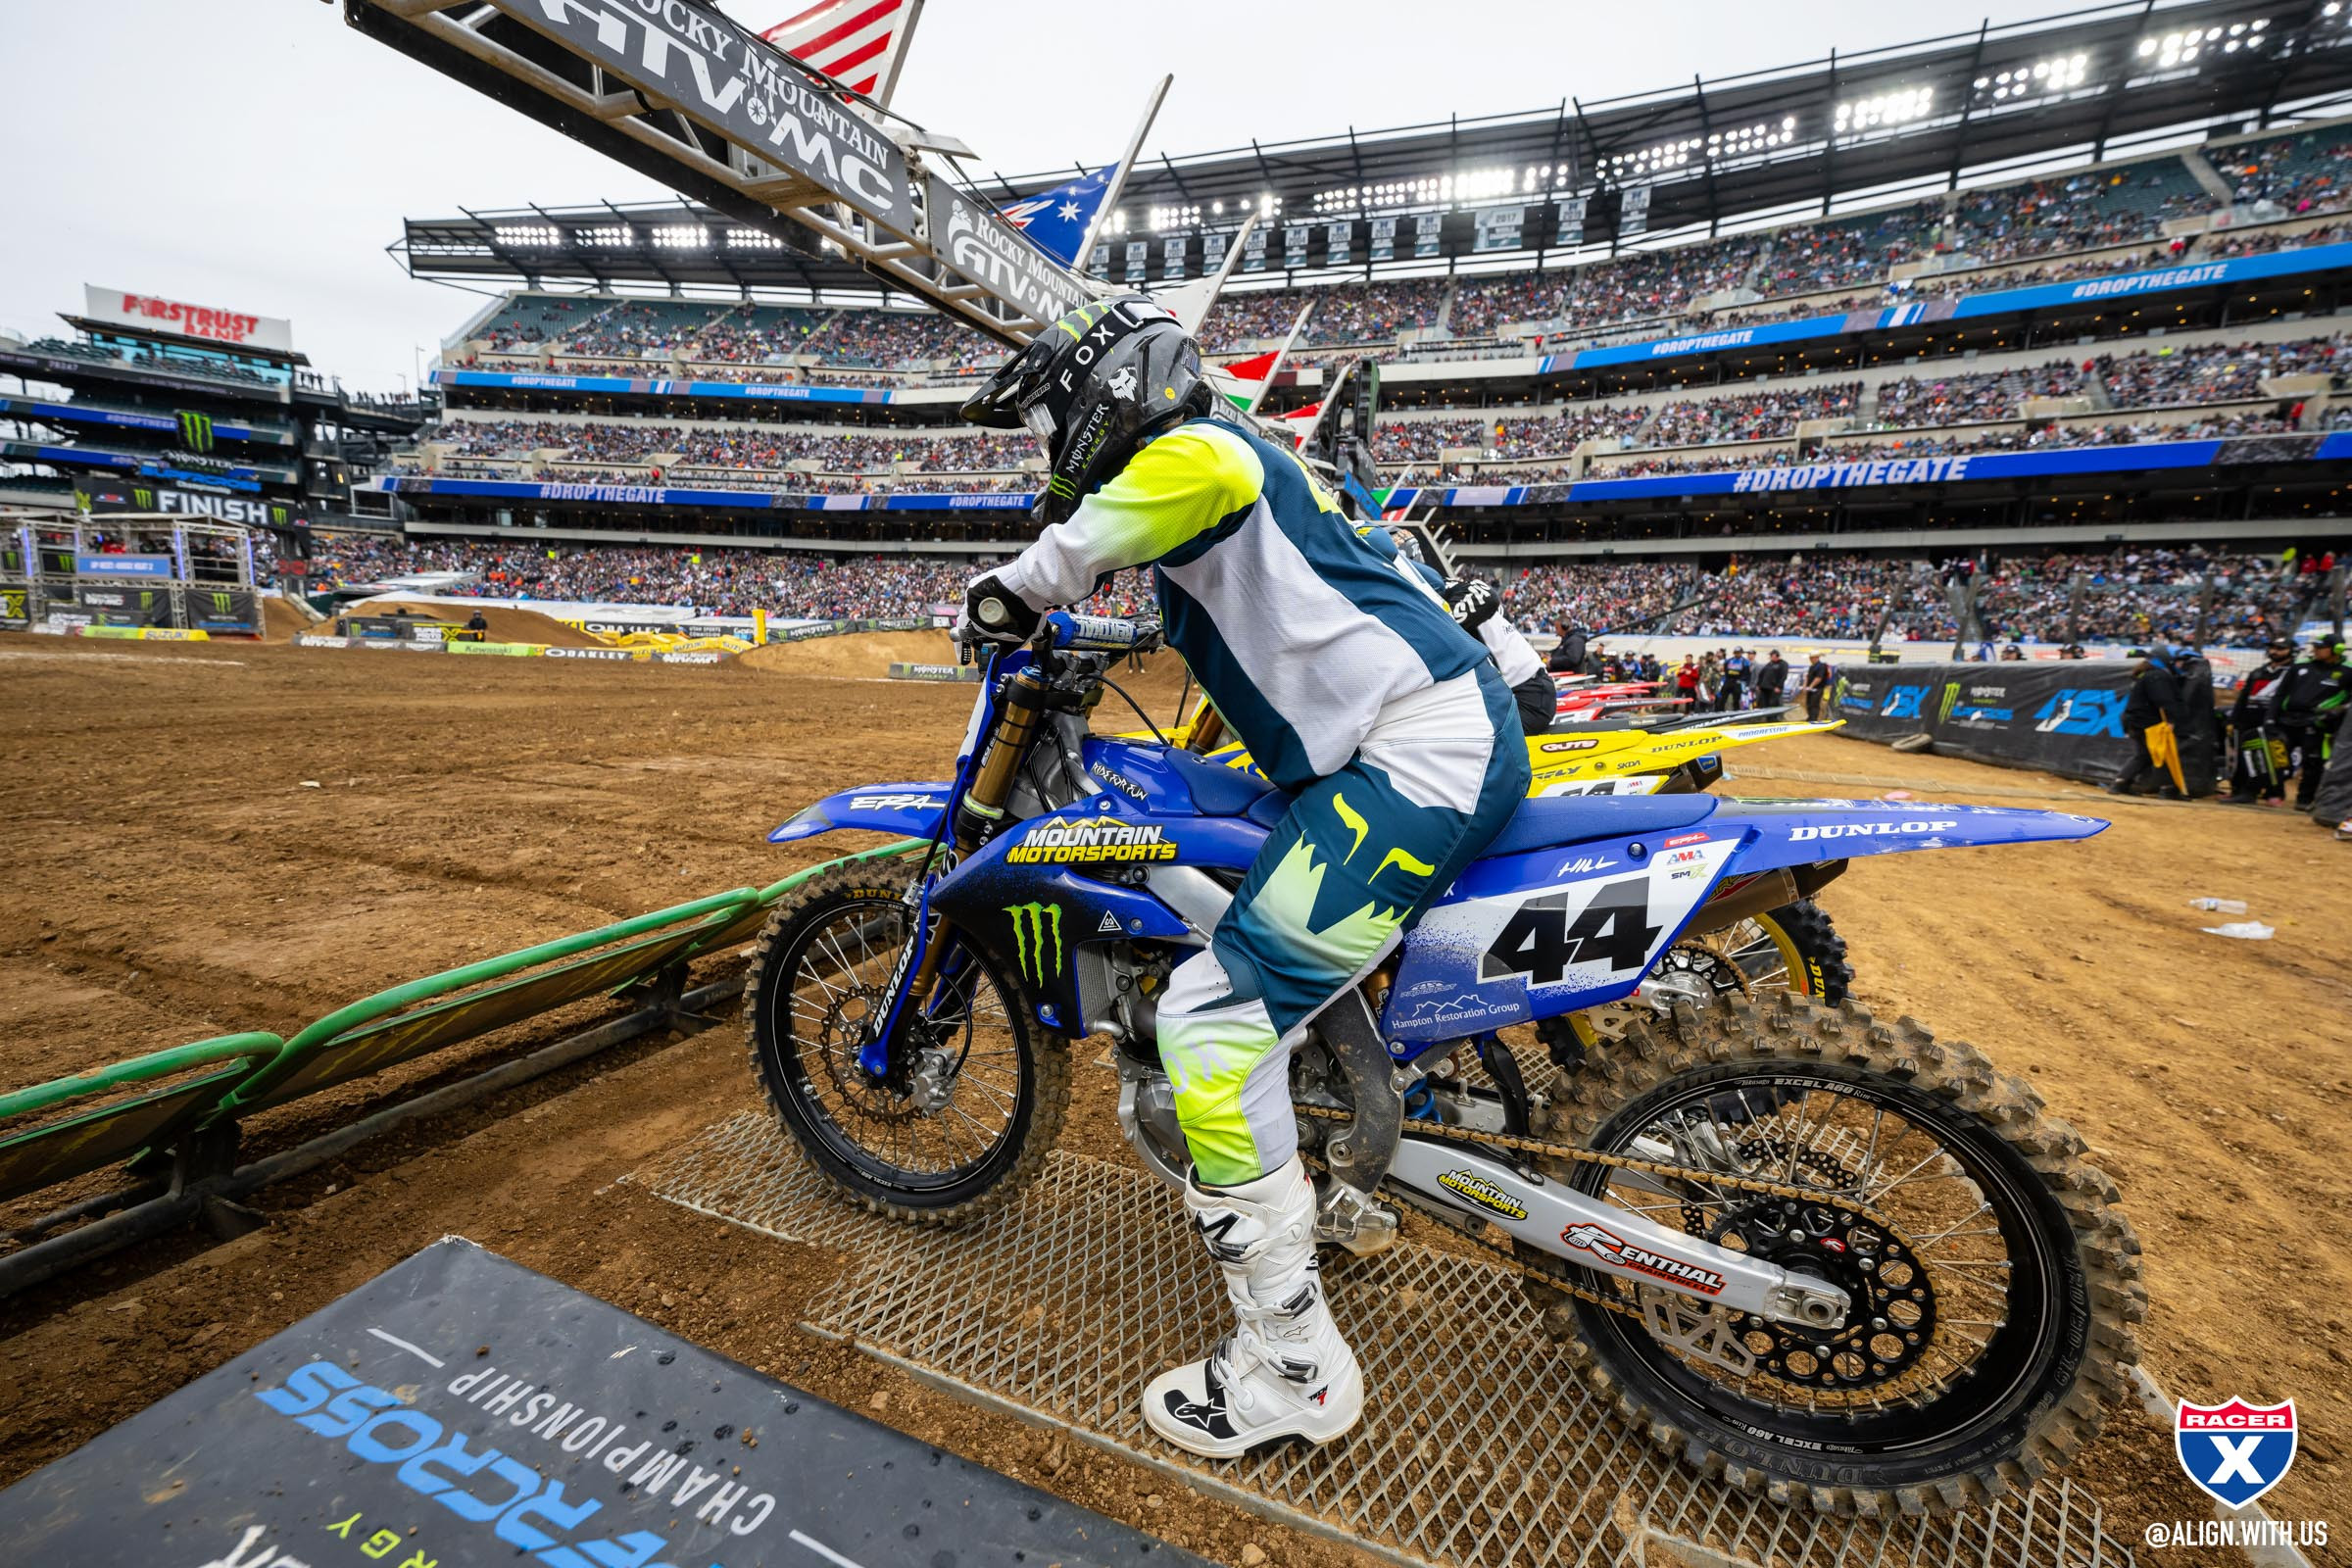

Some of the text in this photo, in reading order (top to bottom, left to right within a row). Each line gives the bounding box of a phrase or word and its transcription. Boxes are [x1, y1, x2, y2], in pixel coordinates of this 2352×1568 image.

[630, 0, 889, 170] OCKY MOUNTAIN
[768, 112, 894, 210] MC
[976, 212, 1027, 267] ROCKY
[954, 235, 1031, 302] ATV
[2072, 264, 2229, 298] #DROPTHEGATE
[183, 320, 246, 343] BANK
[1651, 329, 1754, 356] #DROPTHEGATE
[1058, 323, 1115, 393] FOX
[512, 376, 577, 388] #DROPTHEGATE
[745, 386, 810, 398] #DROPTHEGATE
[1064, 401, 1110, 474] MONSTER
[1081, 419, 1110, 470] ENERGY
[168, 451, 235, 470] MONSTER
[1733, 456, 1973, 493] #DROPTHEGATE
[540, 484, 665, 503] #DROPTHEGATE
[949, 495, 1026, 508] #DROPTHEGATE
[158, 490, 269, 525] FINISH
[790, 624, 833, 638] MONSTER
[878, 617, 916, 628] MONSTER
[145, 630, 191, 642] SUZUKI
[465, 645, 513, 656] Kawasaki
[566, 649, 626, 661] OAKLEY
[913, 665, 954, 675] MONSTER
[1739, 725, 1788, 739] PROGRESSIVE
[1542, 740, 1597, 752] GUTS
[1651, 735, 1724, 754] DUNLOP
[1616, 760, 1642, 770] SKDA
[1091, 761, 1149, 802] RIDE FOR FUN
[1023, 825, 1163, 849] MOUNTAIN
[1788, 820, 1958, 842] DUNLOP
[1007, 843, 1177, 864] MOTORSPORTS
[1667, 850, 1706, 865] AMA
[1557, 856, 1619, 878] HILL
[1481, 877, 1664, 985] 44
[872, 936, 915, 1037] DUNLOP
[1392, 1003, 1520, 1029] Hampton Restoration Group
[1162, 1035, 1233, 1095] OX
[1774, 1078, 1823, 1089] EXCEL
[1824, 1082, 1854, 1094] A60
[1853, 1089, 1872, 1100] Rim
[1439, 1174, 1528, 1220] MOTORSPORTS
[1447, 1170, 1522, 1208] MOUNTAIN
[1561, 1224, 1723, 1289] RENTHAL
[1627, 1260, 1717, 1295] CHAINWHEELS
[1731, 1418, 1748, 1432] Rim
[1746, 1426, 1774, 1441] A60
[447, 1367, 777, 1536] CHAMPIONSHIP
[1776, 1437, 1823, 1451] EXCEL
[1697, 1430, 1863, 1486] DUNLOP
